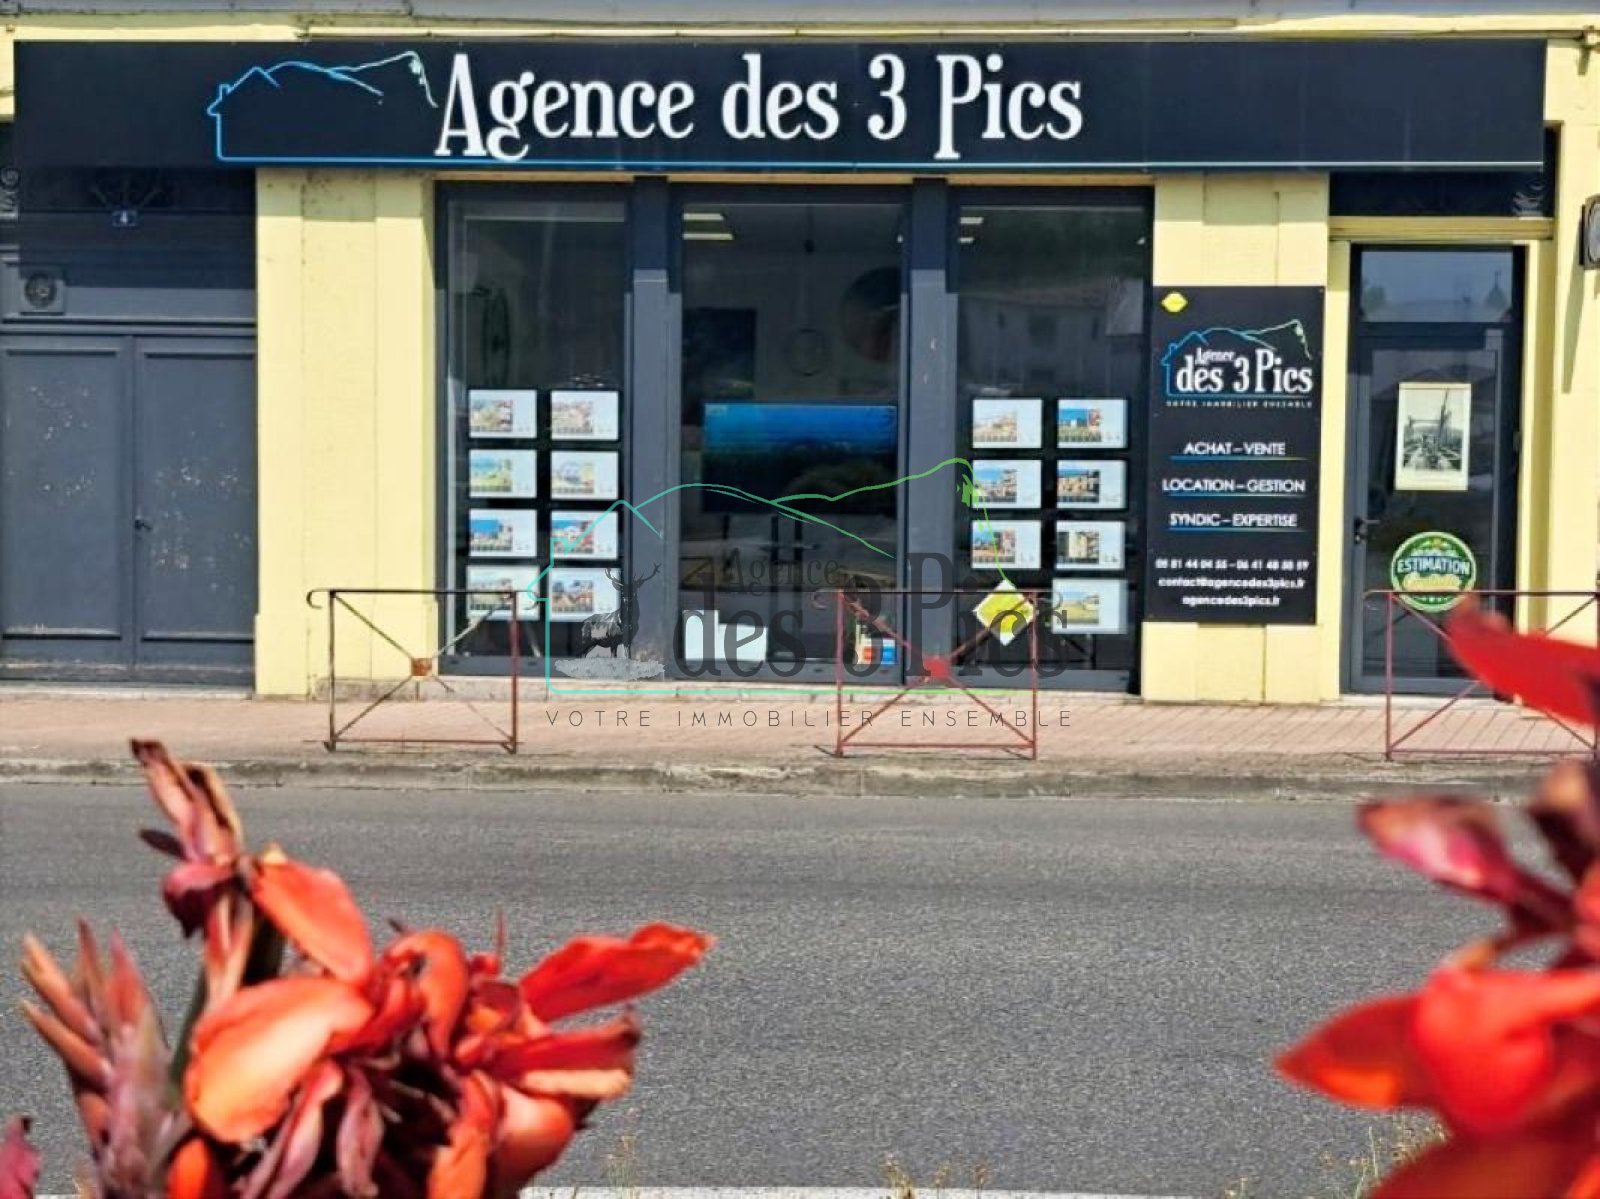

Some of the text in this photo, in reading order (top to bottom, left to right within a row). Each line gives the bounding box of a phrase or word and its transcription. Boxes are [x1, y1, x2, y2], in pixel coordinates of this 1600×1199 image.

[434, 52, 1083, 161] Agence des 3 Pics
[1176, 348, 1314, 393] des 3 Pics
[1183, 442, 1232, 455] ACHAT
[1243, 442, 1286, 455] VENTE
[1162, 478, 1235, 491] LOCATION
[1247, 479, 1306, 492] GESTION
[1169, 513, 1221, 526] SYNDIC
[1232, 513, 1298, 526] EXPERTISE
[1397, 556, 1470, 574] ESTIMATION
